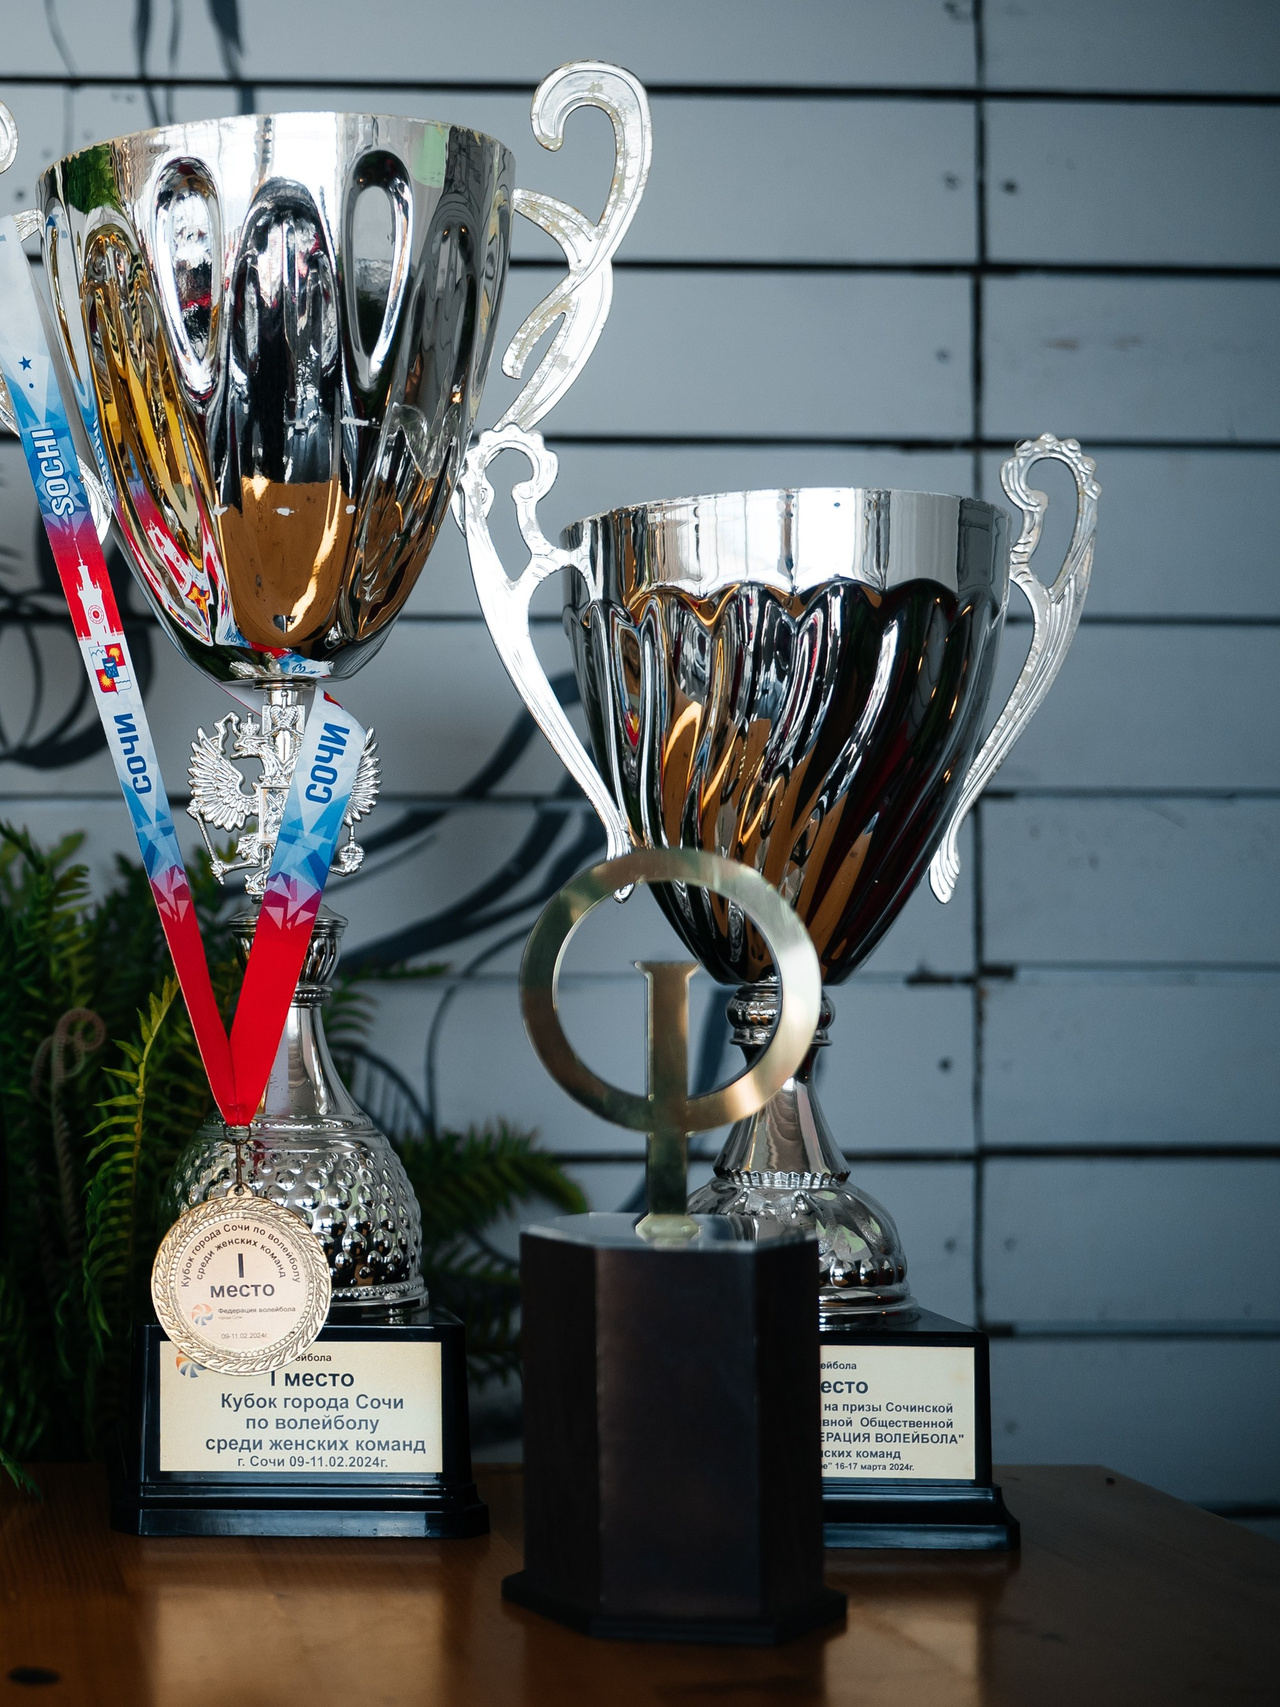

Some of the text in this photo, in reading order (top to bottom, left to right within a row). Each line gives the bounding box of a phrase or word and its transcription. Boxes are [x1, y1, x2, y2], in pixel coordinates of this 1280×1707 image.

[31, 428, 75, 517] SOCHI
[113, 712, 152, 795] СОЧИ
[305, 722, 351, 804] СОЧИ
[181, 1223, 301, 1287] Кубок города Сочи по волейболу
[196, 1238, 286, 1280] среди женских команд
[210, 1283, 275, 1298] место
[284, 1372, 355, 1387] место
[821, 1380, 869, 1394] есто
[221, 1393, 404, 1412] Кубок города Сочи
[824, 1402, 953, 1414] на призы Сочинской
[246, 1414, 379, 1434] по волейболу
[860, 1417, 954, 1429] Общественной
[875, 1431, 964, 1445] ВОЛЕЙБОЛА"
[205, 1438, 426, 1454] среди женских команд
[237, 1456, 388, 1468] г. Сочи 09-11.02.2024г.
[856, 1450, 901, 1460] команд
[835, 1462, 858, 1470] 16-17
[860, 1464, 887, 1472] марта
[889, 1463, 915, 1471] 2024г.
